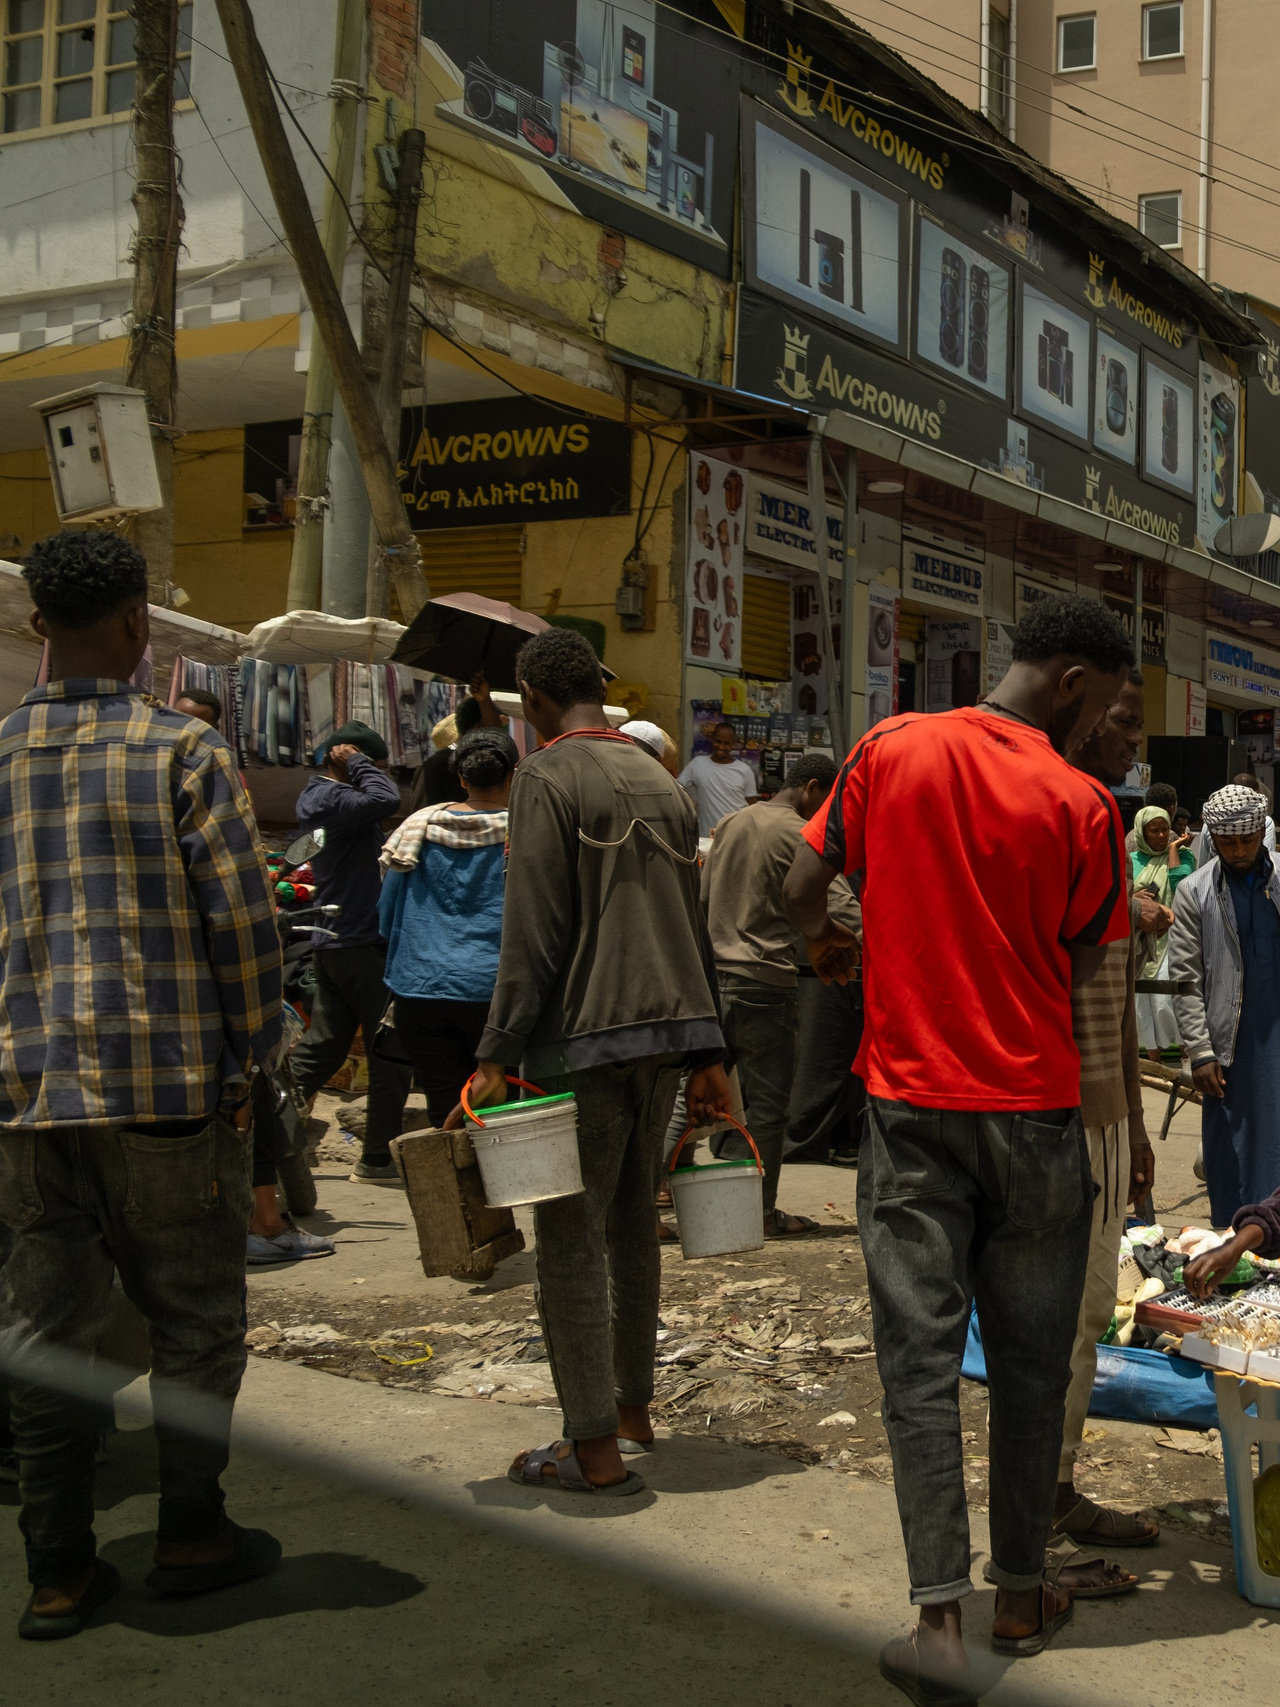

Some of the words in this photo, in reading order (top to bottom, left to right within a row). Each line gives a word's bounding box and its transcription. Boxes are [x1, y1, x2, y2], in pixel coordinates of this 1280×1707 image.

[818, 79, 944, 190] AVCROWNS
[1107, 276, 1183, 349] AVCROWNS
[815, 354, 942, 440] AVCROWNS
[410, 423, 590, 467] AVCROWNS
[1104, 485, 1180, 545] AVCROWNS
[912, 577, 979, 605] ELECTRONICS
[914, 552, 982, 590] MEHBUB
[869, 670, 889, 683] beko
[1213, 671, 1230, 683] SONY
[1245, 681, 1264, 693] SAMSUNG
